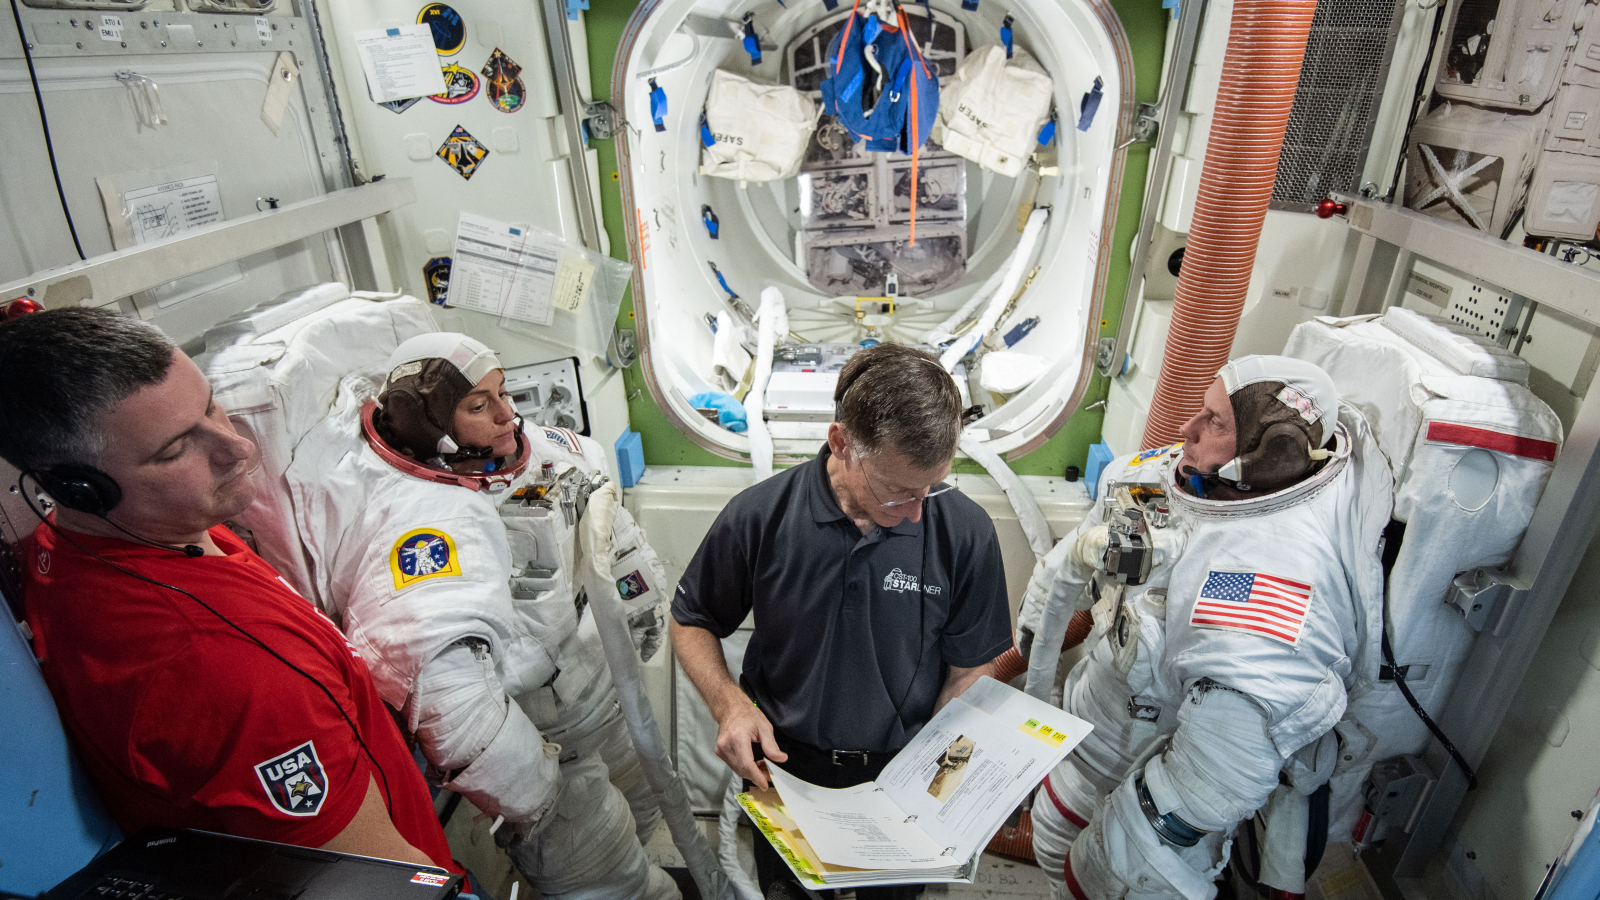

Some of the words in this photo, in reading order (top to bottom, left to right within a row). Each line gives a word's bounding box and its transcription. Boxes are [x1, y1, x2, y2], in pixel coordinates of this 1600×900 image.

[104, 18, 115, 26] ATU
[893, 572, 918, 582] CST-100
[892, 579, 942, 595] STARLNER
[266, 752, 312, 781] USA
